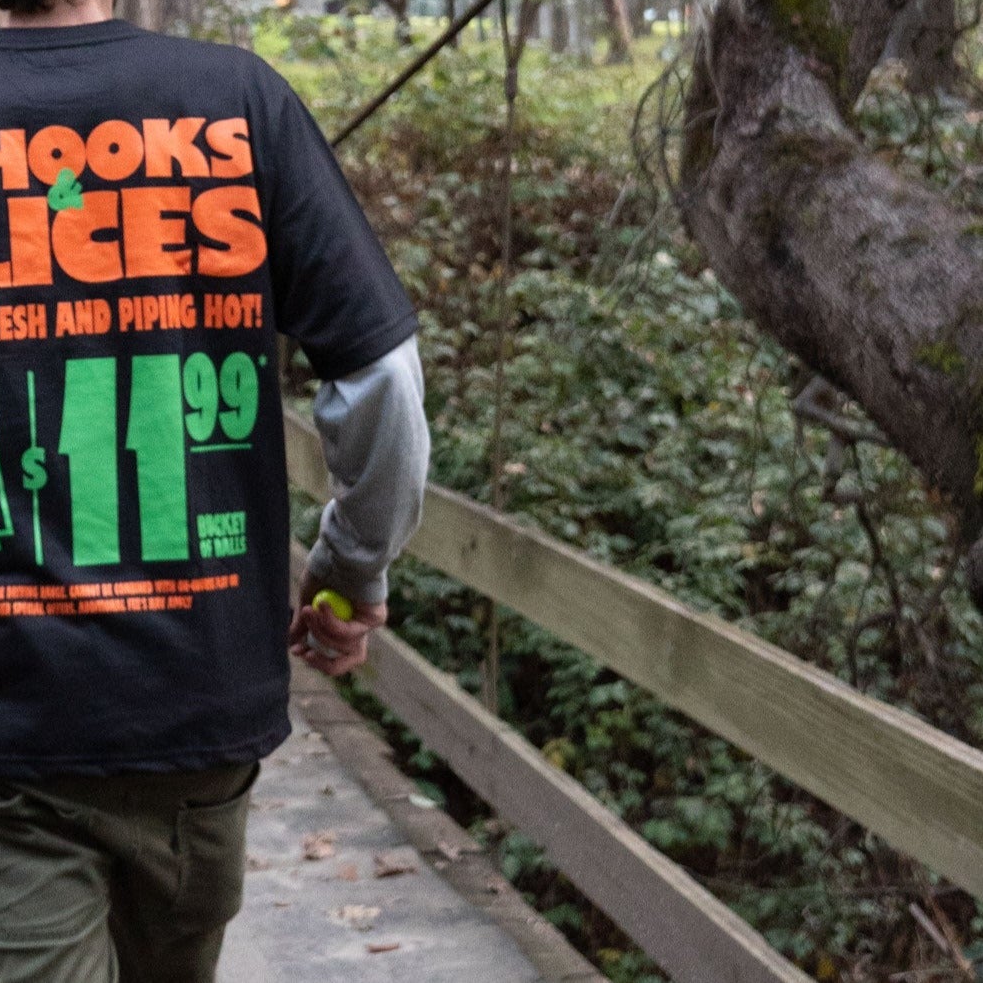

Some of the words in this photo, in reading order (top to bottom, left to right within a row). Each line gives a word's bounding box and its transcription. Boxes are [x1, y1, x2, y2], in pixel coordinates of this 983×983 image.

[47, 166, 84, 211] &
[55, 299, 112, 337] AND
[118, 293, 197, 332] PIPING
[203, 293, 263, 328] HOT!
